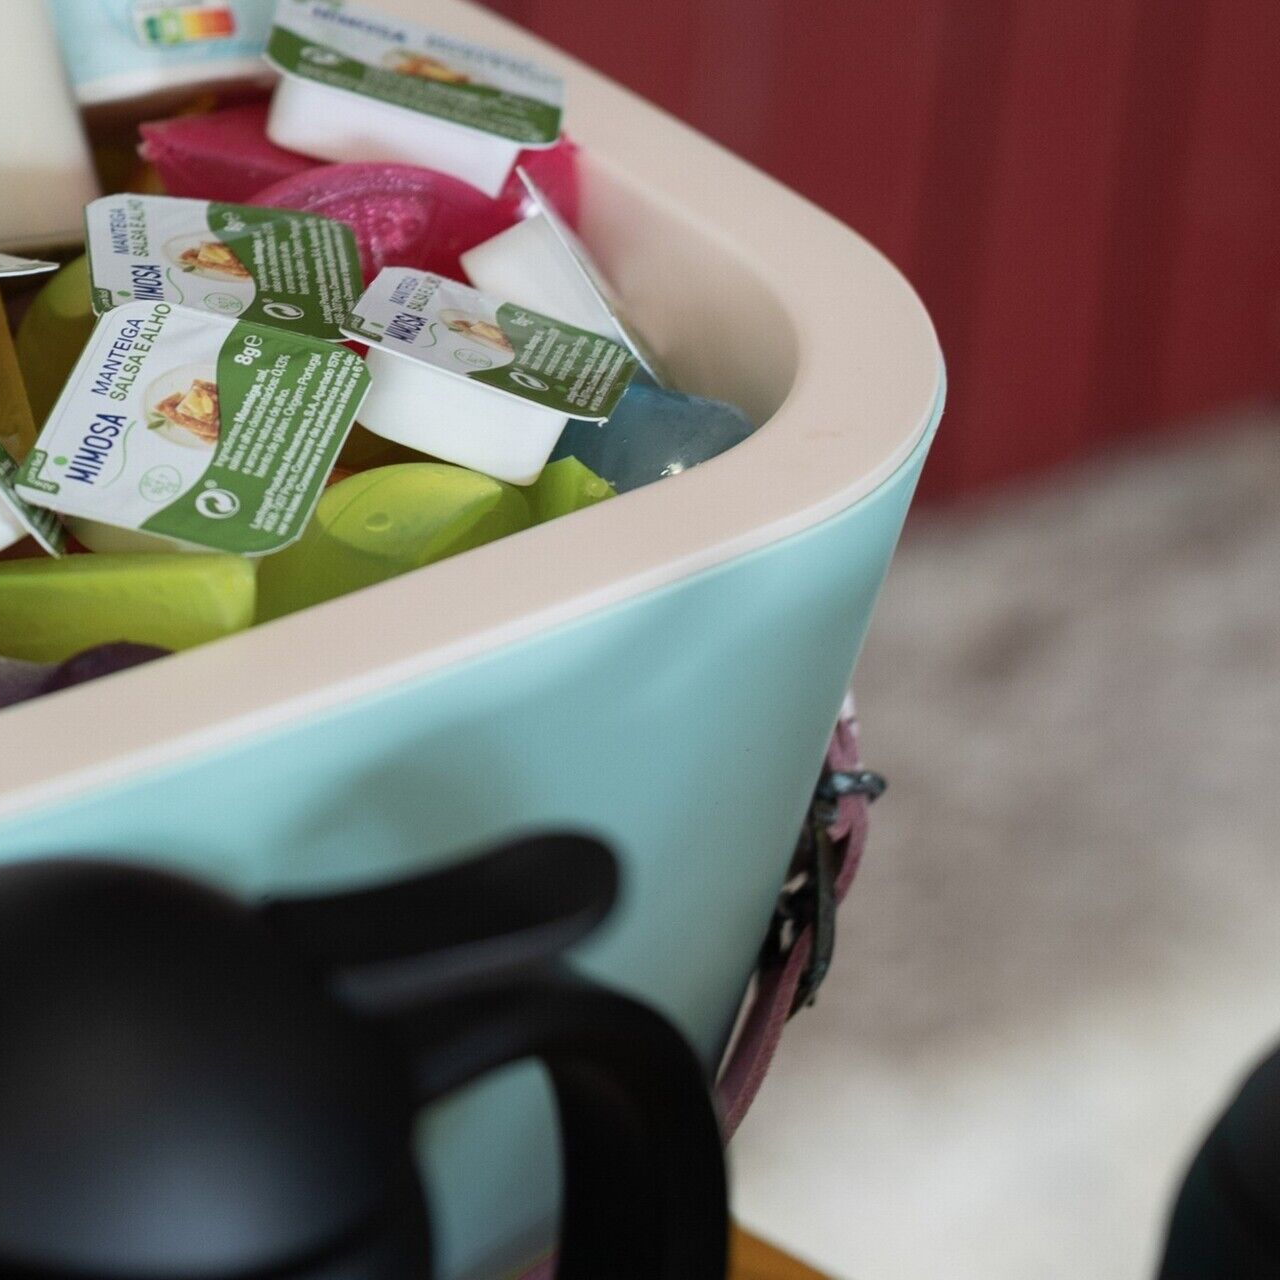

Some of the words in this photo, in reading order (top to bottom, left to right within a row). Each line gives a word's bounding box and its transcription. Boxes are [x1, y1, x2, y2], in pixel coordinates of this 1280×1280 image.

[91, 318, 144, 397] MANTEIGA
[110, 352, 144, 402] SALSA
[142, 301, 171, 342] ALHO
[65, 412, 128, 485] MIMOSA
